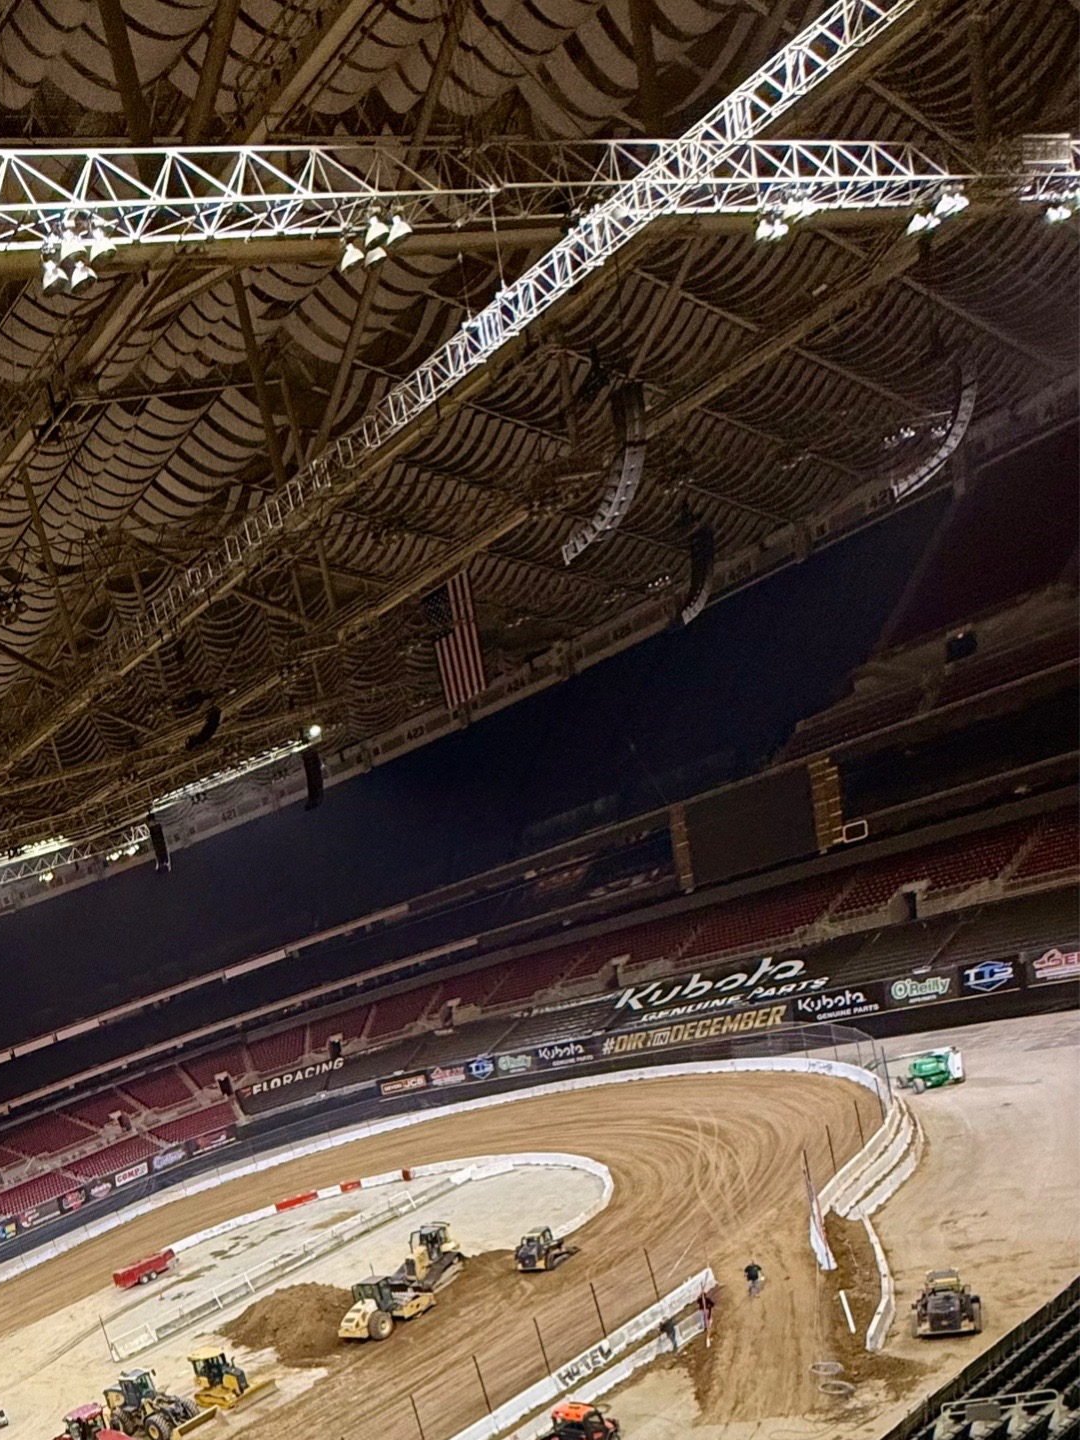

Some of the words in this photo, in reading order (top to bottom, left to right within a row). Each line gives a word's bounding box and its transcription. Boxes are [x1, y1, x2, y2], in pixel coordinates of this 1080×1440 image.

[406, 725, 425, 740] 423
[221, 808, 237, 822] 421
[615, 956, 807, 1010] Kubota
[891, 977, 950, 1000] O'Reilly
[640, 996, 743, 1021] GENUINE
[747, 977, 829, 999] PARTS
[797, 990, 867, 1012] Kubota
[816, 1008, 851, 1020] GENUINE
[853, 1003, 879, 1015] PARTS
[539, 1043, 584, 1059] Kubota
[252, 1057, 344, 1095] FLORACING
[405, 1076, 425, 1088] JCB
[557, 1345, 612, 1387] HOTEL
